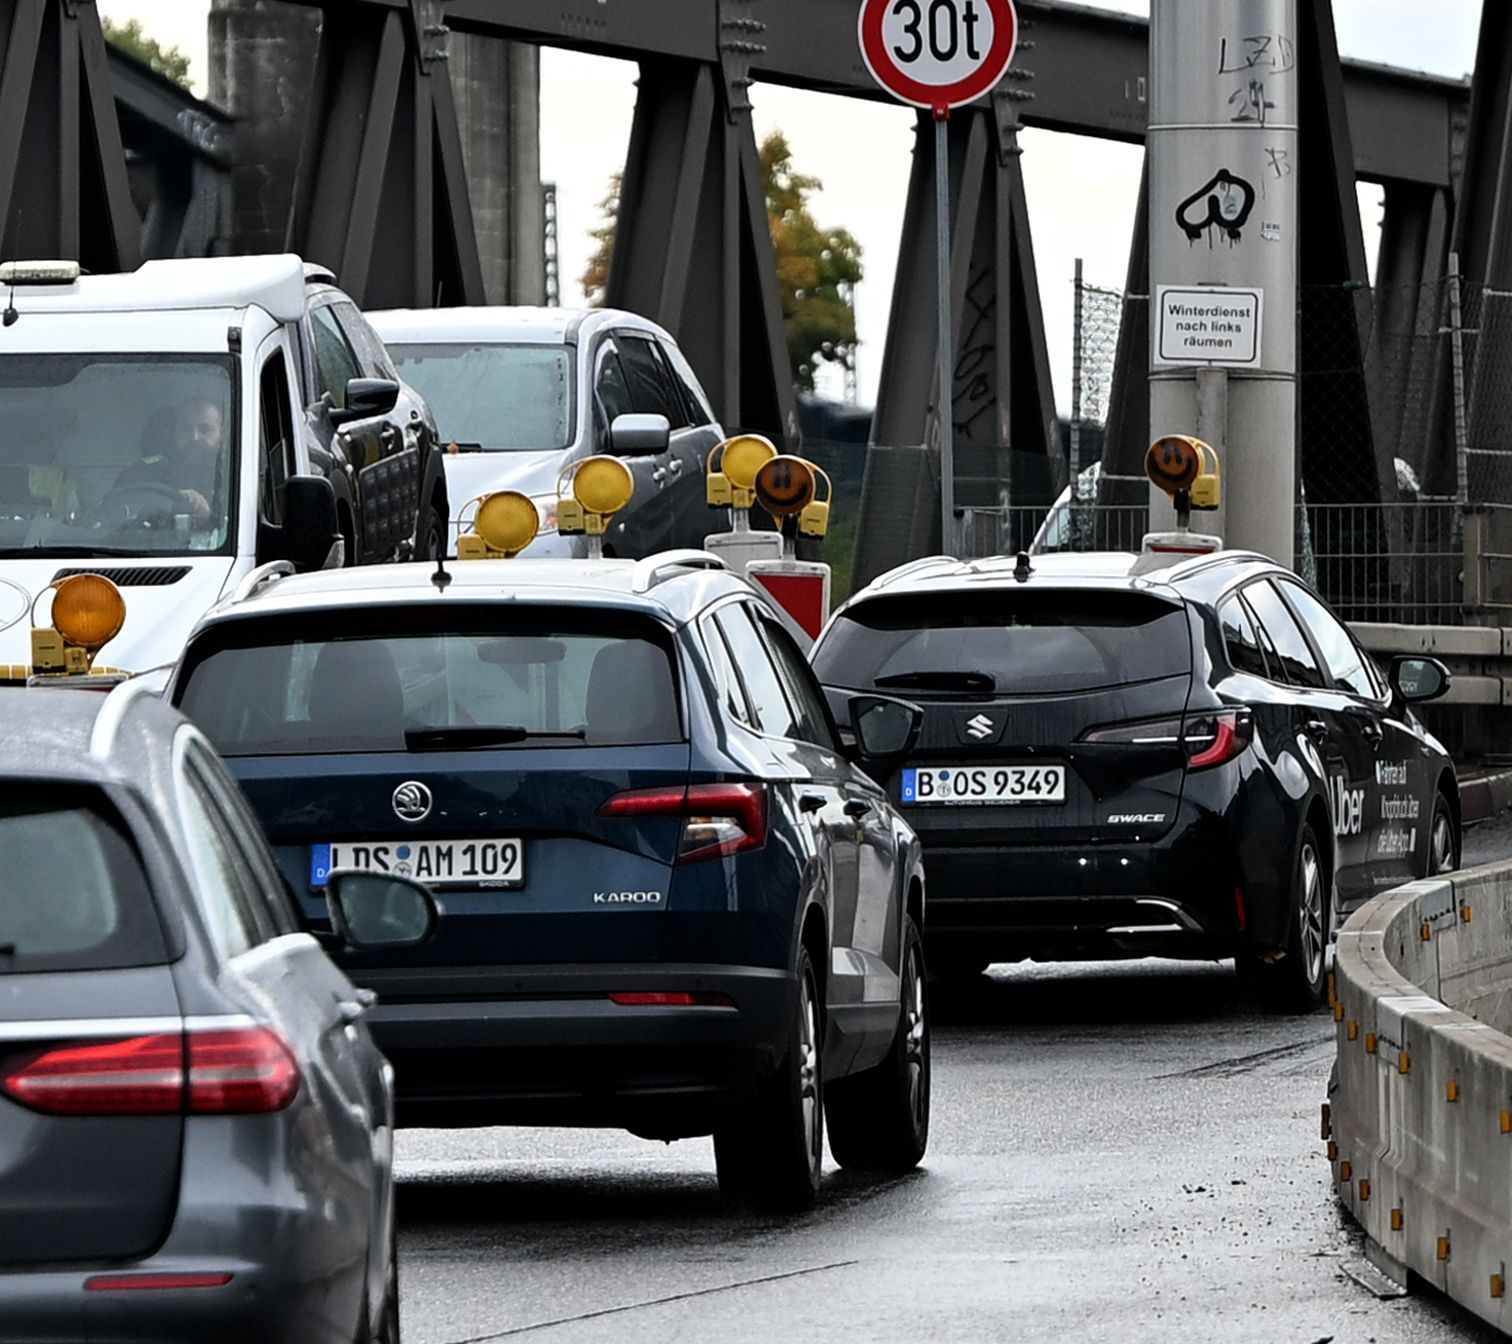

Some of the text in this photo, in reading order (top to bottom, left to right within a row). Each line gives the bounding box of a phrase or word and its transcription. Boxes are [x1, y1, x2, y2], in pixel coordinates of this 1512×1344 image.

[1168, 303, 1251, 318] Winterdienst
[1175, 320, 1242, 333] nach links
[1183, 336, 1233, 348] räumen
[918, 771, 934, 797] B
[953, 770, 987, 796] OS
[993, 768, 1060, 796] 9349
[1330, 775, 1365, 836] Uber
[1107, 813, 1166, 824] SWACE
[415, 844, 453, 878] AM
[461, 842, 518, 876] 109
[593, 892, 662, 904] KAROQ
